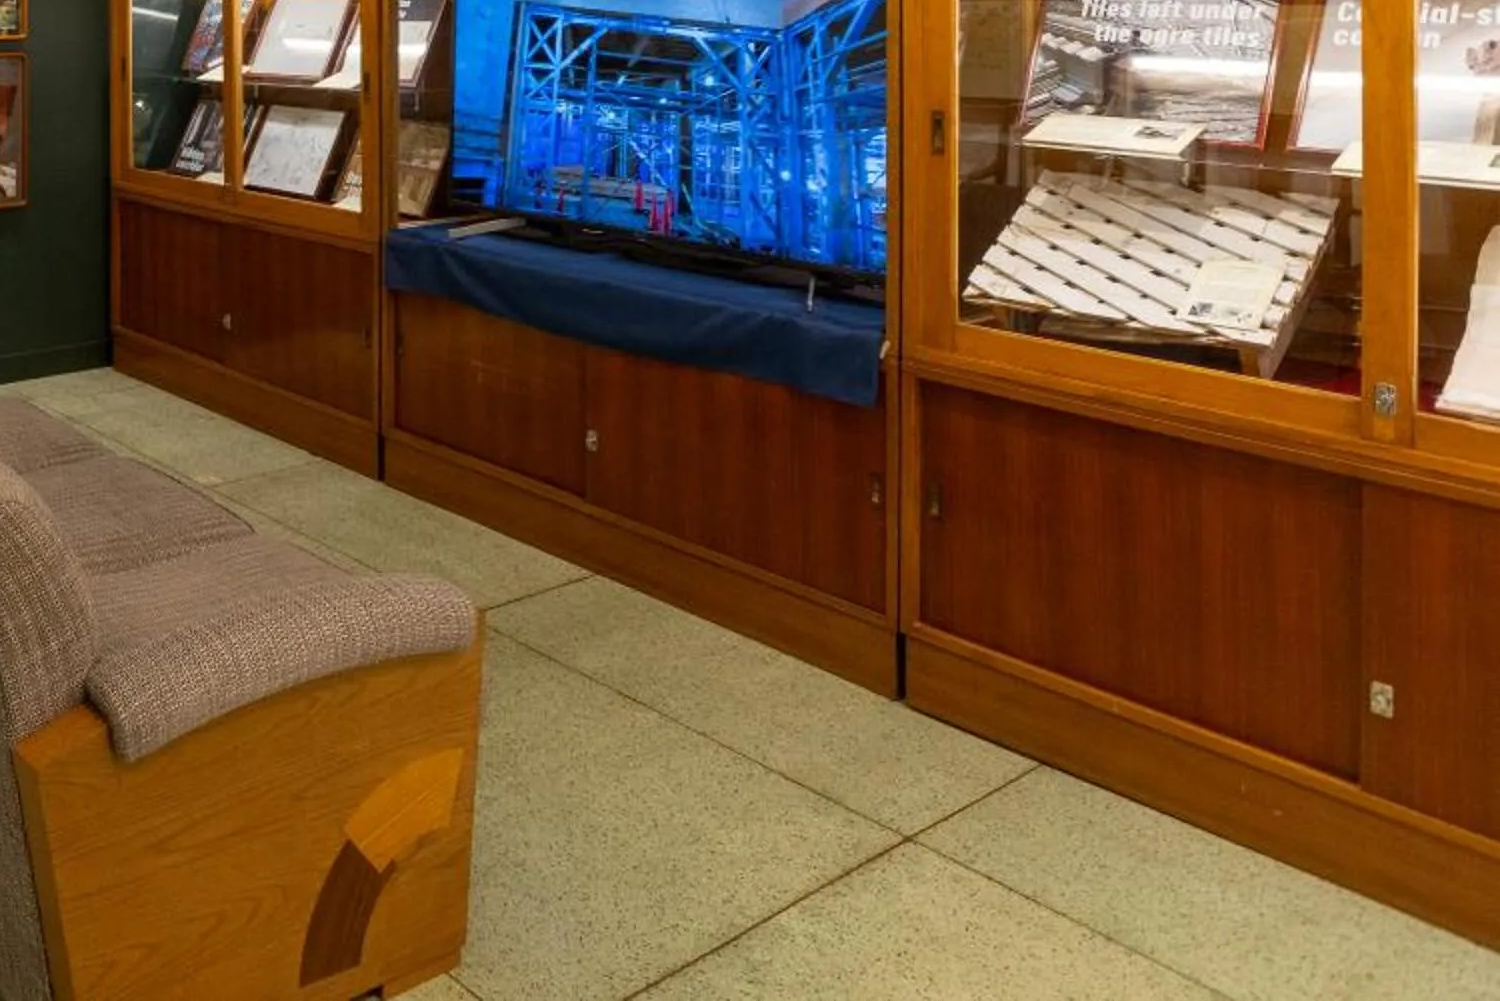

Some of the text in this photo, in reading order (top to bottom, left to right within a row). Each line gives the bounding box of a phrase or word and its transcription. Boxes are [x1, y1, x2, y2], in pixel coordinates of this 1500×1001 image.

[1190, 1, 1264, 20] under
[1094, 24, 1132, 44] the
[1201, 25, 1262, 48] tiles
